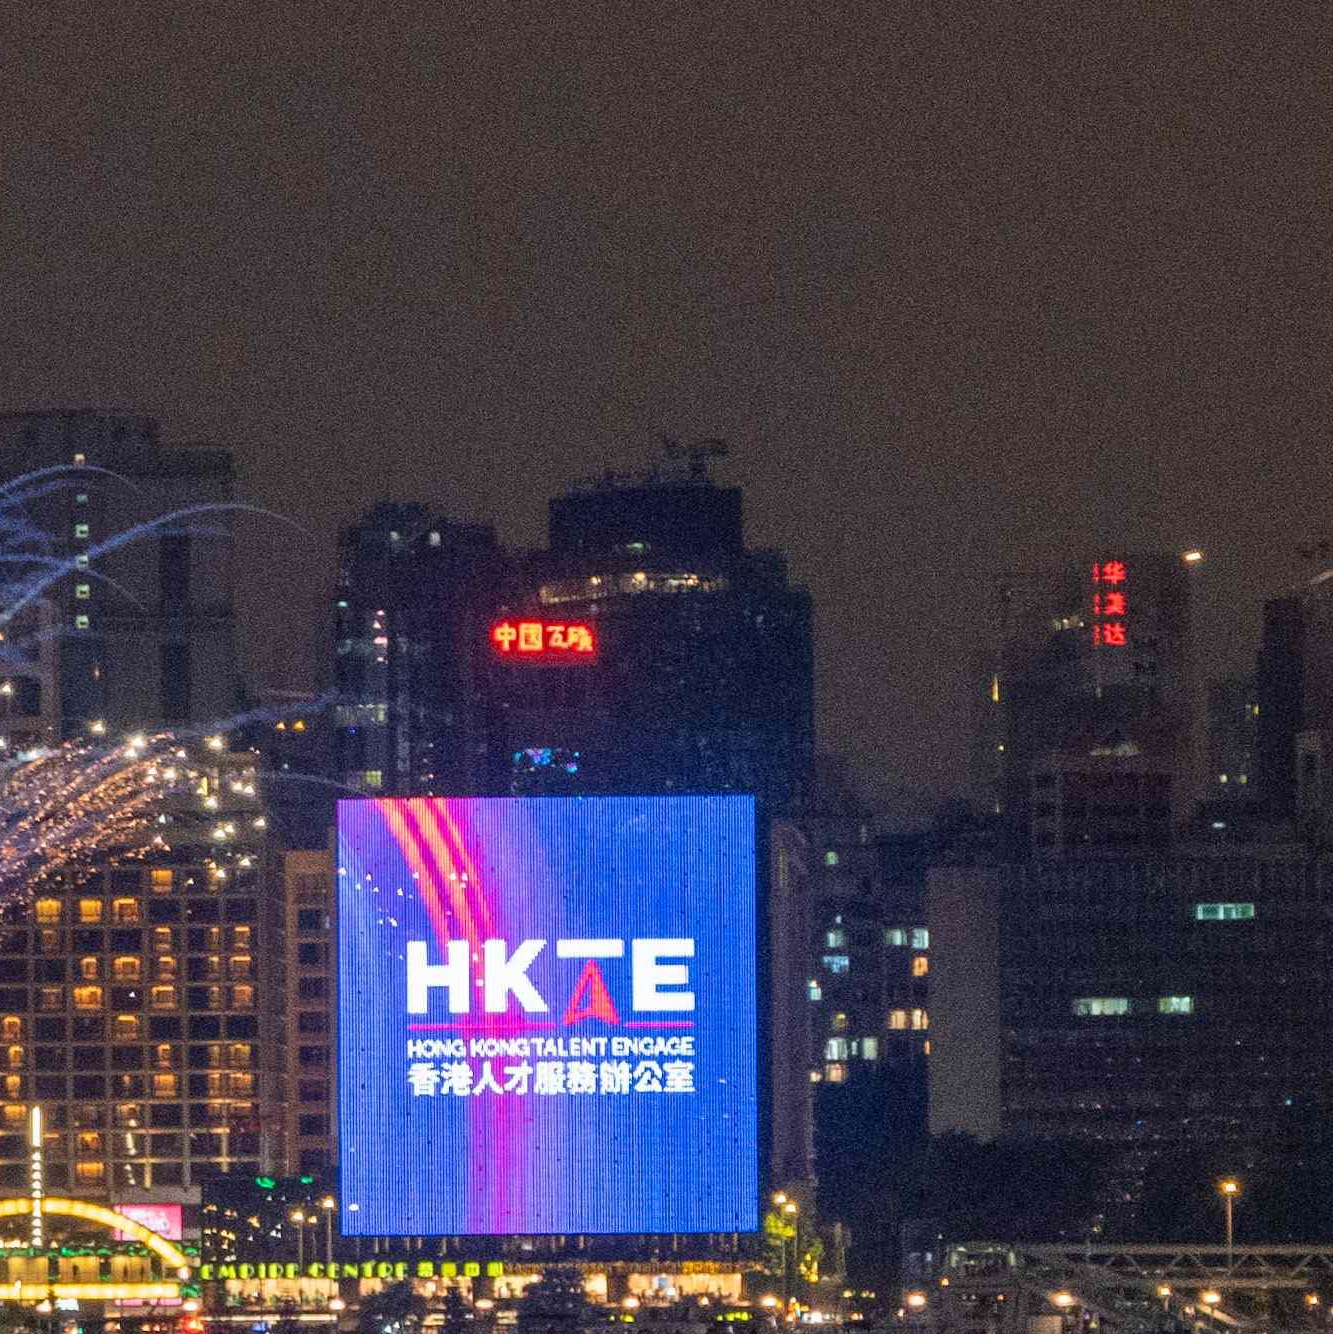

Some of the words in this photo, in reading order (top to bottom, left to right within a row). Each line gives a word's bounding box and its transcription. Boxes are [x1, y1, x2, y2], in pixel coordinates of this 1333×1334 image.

[407, 1037, 467, 1059] HONG
[470, 1037, 530, 1058] KONG
[531, 1036, 609, 1058] TALENT
[611, 1036, 696, 1057] ENGAGE
[407, 1058, 696, 1097] 香港人才服務辦公室
